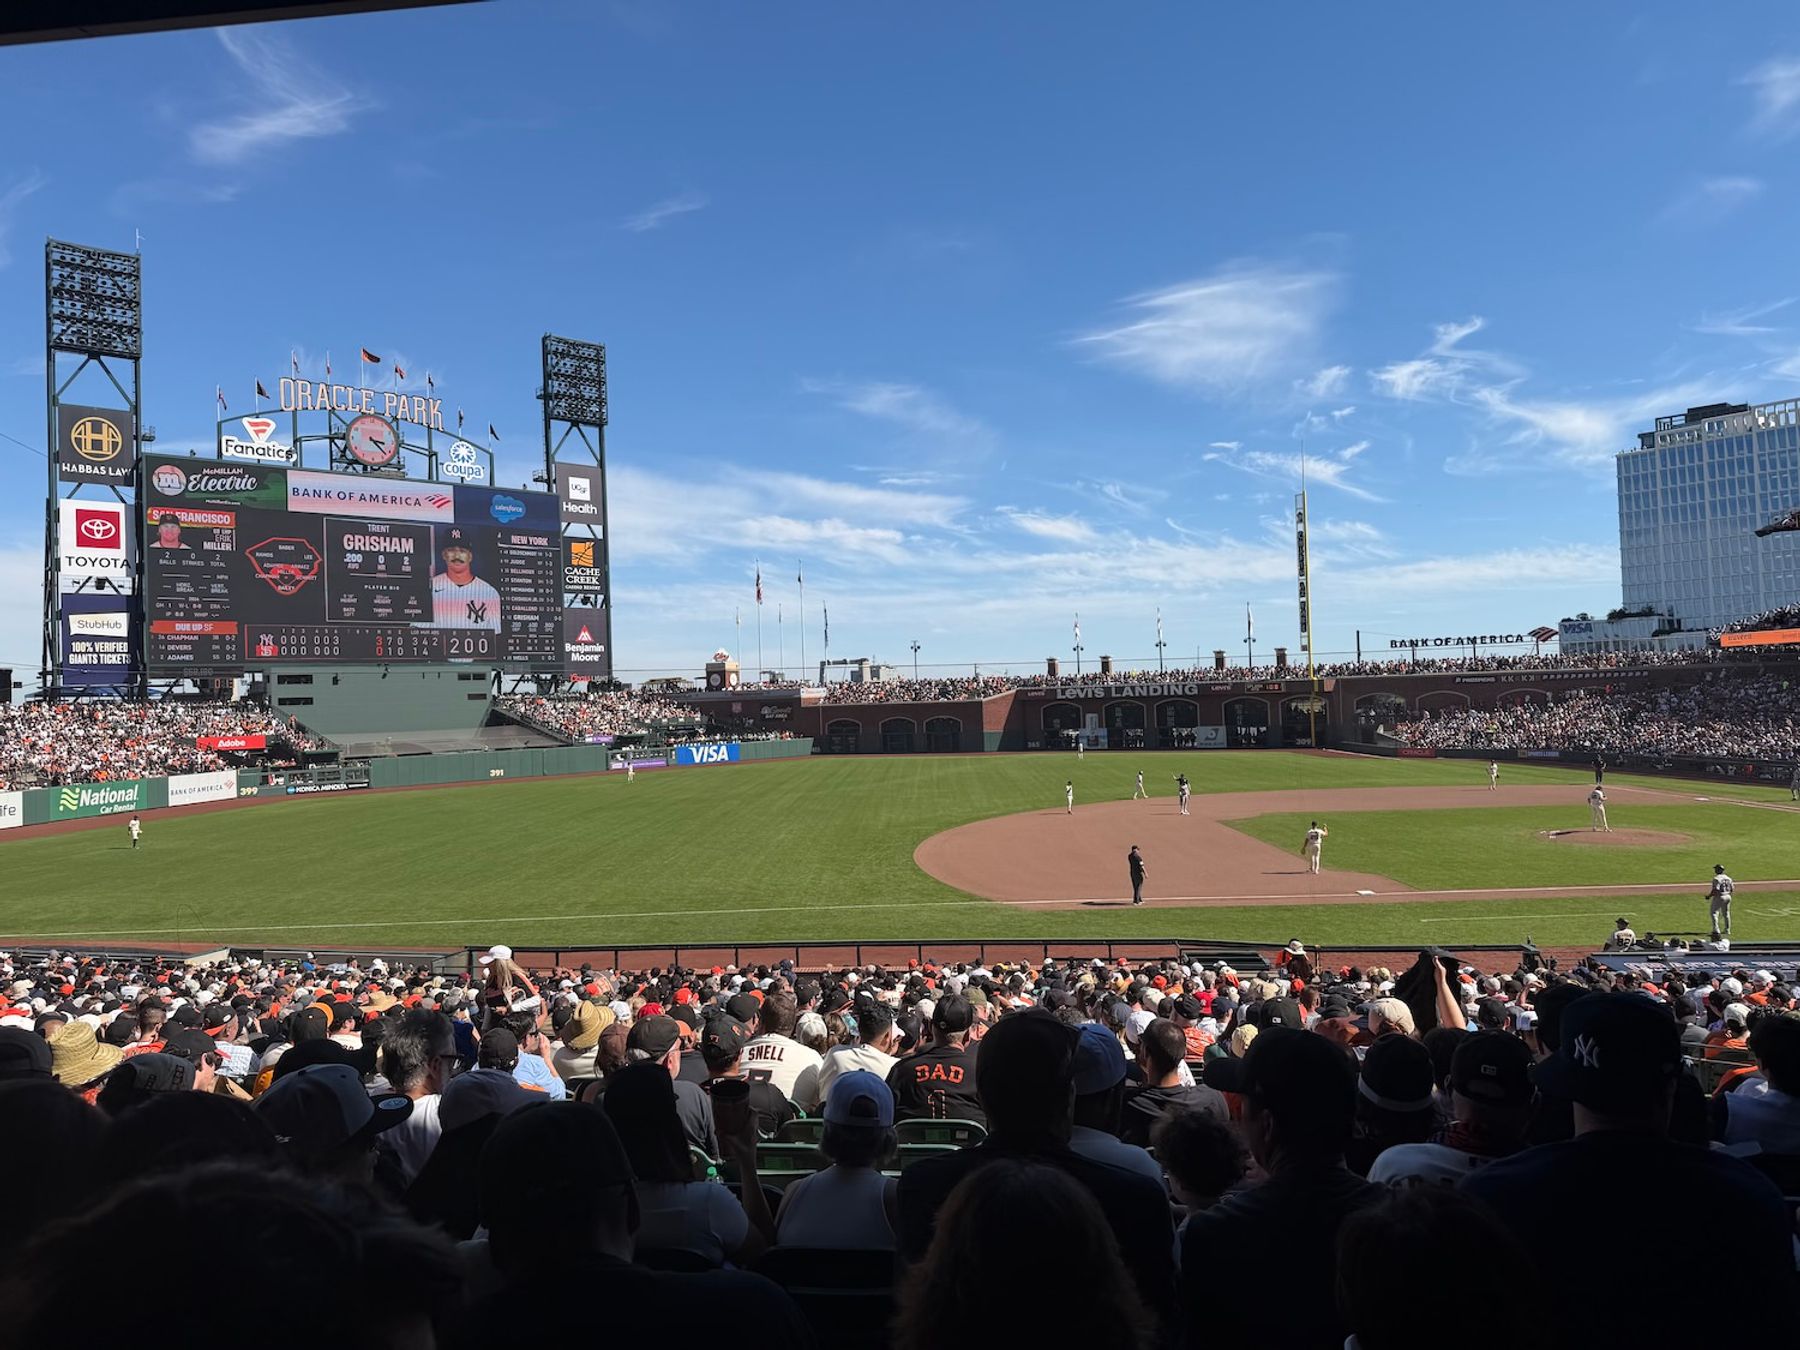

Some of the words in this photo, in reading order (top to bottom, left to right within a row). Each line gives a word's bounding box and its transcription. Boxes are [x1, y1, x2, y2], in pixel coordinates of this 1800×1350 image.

[279, 377, 375, 413] ORACLE
[384, 392, 442, 431] PARK
[225, 439, 293, 460] Fanatics
[62, 463, 106, 475] HABBAS
[445, 465, 481, 478] coupa
[188, 474, 257, 492] Electric
[571, 483, 588, 494] UCSF
[292, 487, 332, 499] BANK
[337, 490, 354, 501] OF
[358, 493, 421, 507] AMERICA
[562, 501, 598, 515] Health
[176, 511, 231, 524] FRANCISCO
[368, 524, 389, 533] TRENT
[203, 541, 232, 551] MILLER
[343, 534, 414, 553] GRISHAM
[511, 535, 528, 544] NEW
[529, 536, 549, 546] YORK
[65, 556, 131, 569] TOYOTA
[344, 553, 363, 562] .200
[378, 555, 384, 563] 0
[403, 556, 409, 565] 2
[565, 567, 600, 576] CACHE
[566, 575, 600, 585] CREEK
[466, 600, 487, 624] NY
[77, 619, 122, 630] StubHub
[192, 623, 203, 631] UP
[1561, 622, 1594, 634] VISA
[281, 635, 287, 645] 0
[290, 635, 297, 645] 0
[300, 635, 307, 645] 0
[314, 635, 320, 645] 0
[323, 635, 330, 645] 0
[333, 635, 339, 645] 3
[376, 635, 382, 646] 3
[387, 637, 393, 646] 7
[397, 637, 403, 646] 0
[412, 637, 418, 646] 3
[422, 637, 428, 646] 4
[432, 637, 438, 646] 2
[450, 638, 459, 653] 2
[464, 638, 474, 653] 0
[478, 638, 488, 653] 0
[1390, 638, 1429, 648] BANK
[1434, 637, 1451, 646] OF
[1456, 634, 1524, 646] AMERICA
[71, 642, 93, 652] 100%
[94, 642, 128, 652] VERIFIED
[281, 646, 287, 655] 0
[290, 646, 297, 655] 0
[301, 646, 307, 655] 0
[314, 646, 320, 655] 0
[324, 646, 330, 655] 0
[333, 646, 339, 655] 0
[376, 647, 382, 656] 0
[387, 647, 392, 656] 1
[397, 647, 403, 656] 0
[413, 647, 417, 656] 1
[422, 647, 428, 656] 4
[565, 643, 604, 654] Benjamin
[69, 654, 98, 664] GIANTS
[99, 654, 131, 665] TICKETS
[571, 652, 600, 662] Moore
[1111, 684, 1198, 697] LANDING
[218, 738, 246, 748] Adobe
[689, 746, 729, 764] VISA
[490, 769, 504, 777] 391
[171, 787, 187, 796] BANK
[188, 786, 196, 794] OF
[196, 784, 223, 793] AMERICA
[239, 786, 258, 796] 399
[321, 783, 348, 791] MINOLTA
[79, 785, 138, 807] National
[100, 806, 112, 815] Car
[114, 802, 136, 813] Rental
[748, 1045, 784, 1062] SNELL
[1574, 1033, 1599, 1069] NY
[915, 1063, 965, 1084] DAD
